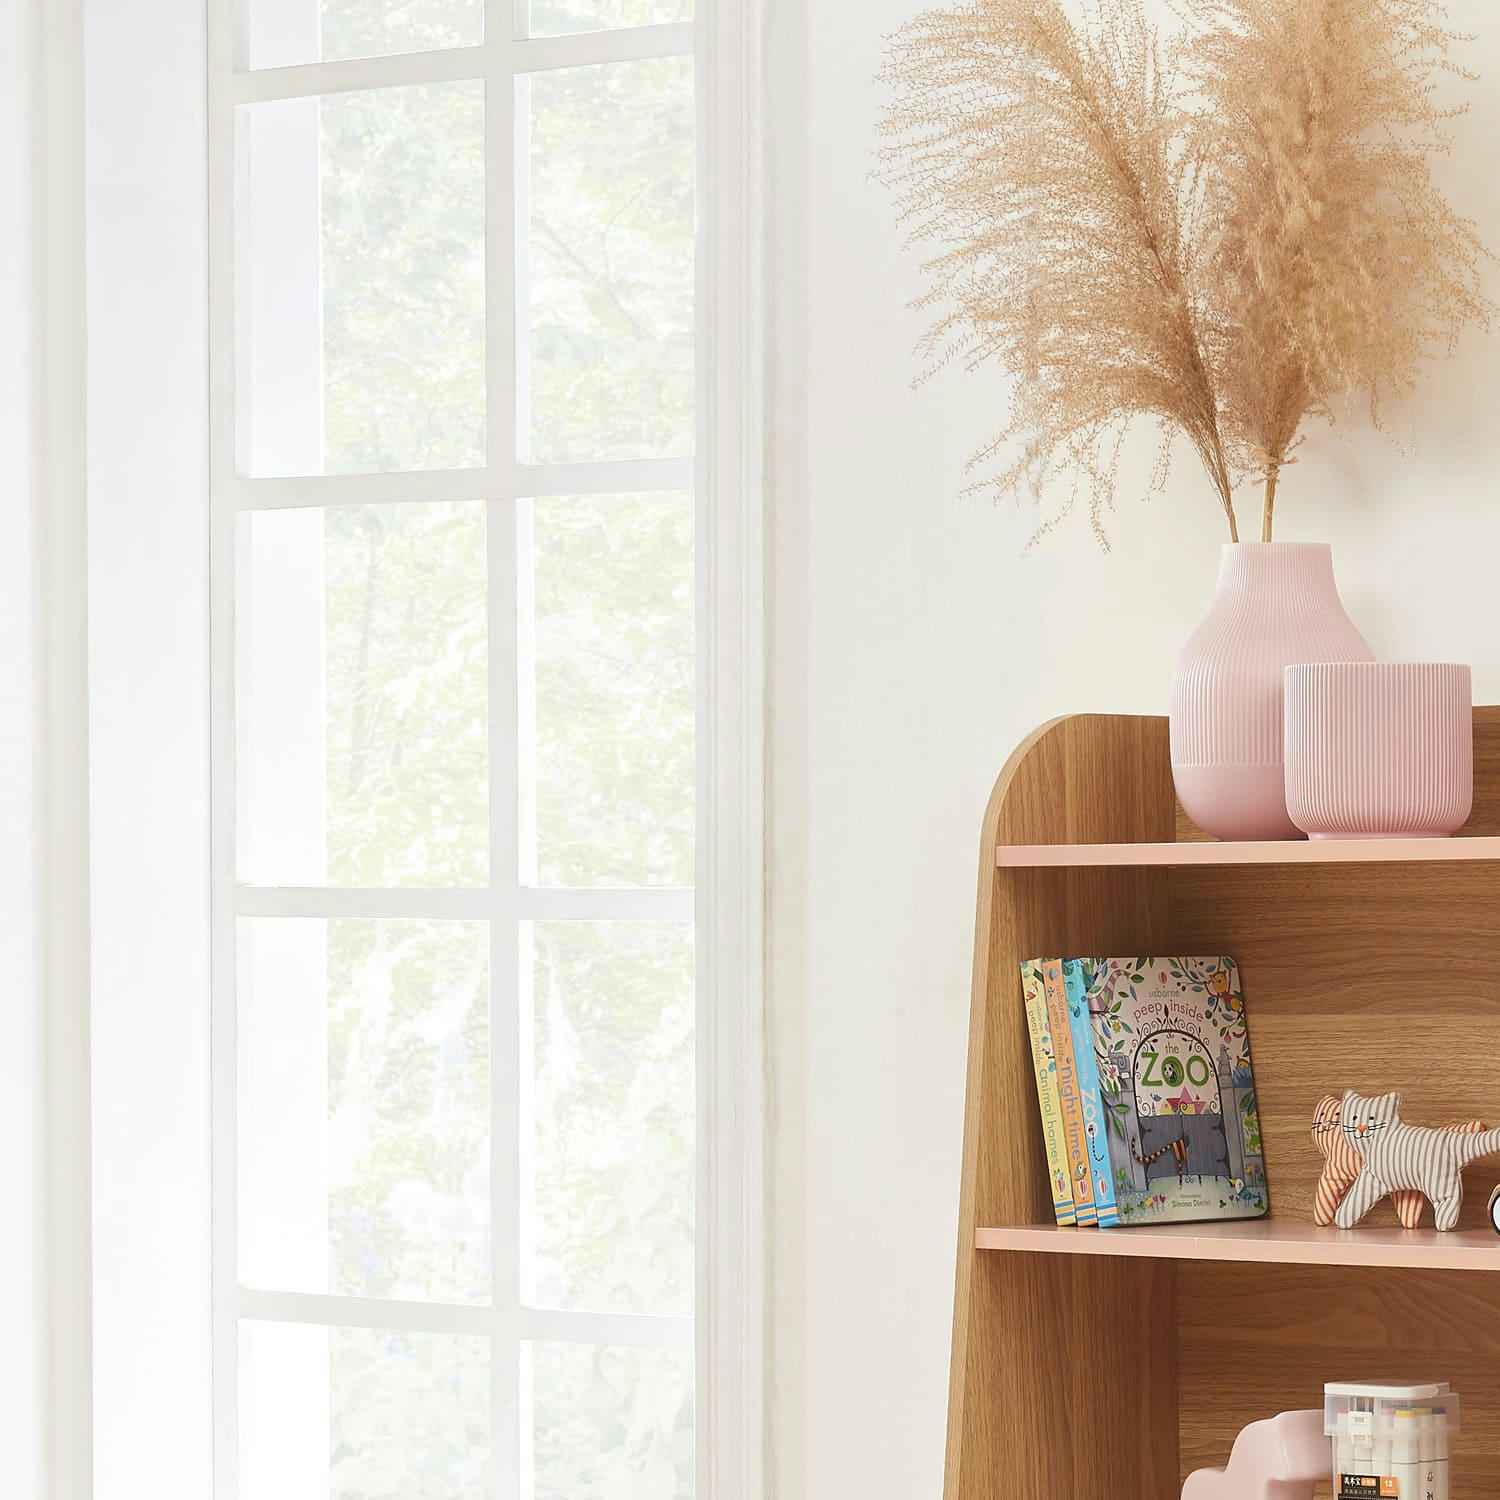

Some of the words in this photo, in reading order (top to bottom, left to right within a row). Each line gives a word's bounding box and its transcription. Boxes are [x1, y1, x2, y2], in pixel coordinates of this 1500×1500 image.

[1056, 985, 1065, 1023] usborne
[1133, 1002, 1162, 1023] peep
[1170, 1000, 1203, 1022] inside
[1148, 988, 1180, 998] usborne
[1029, 1010, 1038, 1034] peep
[1034, 1038, 1043, 1065] inside
[1050, 1004, 1061, 1029] peep
[1057, 1032, 1066, 1062] inside
[1165, 1042, 1180, 1054] the
[1140, 1052, 1210, 1087] ZOO
[1040, 1068, 1055, 1116] animal
[1061, 1066, 1078, 1115] night
[1047, 1120, 1059, 1165] homes
[1068, 1121, 1082, 1161] time
